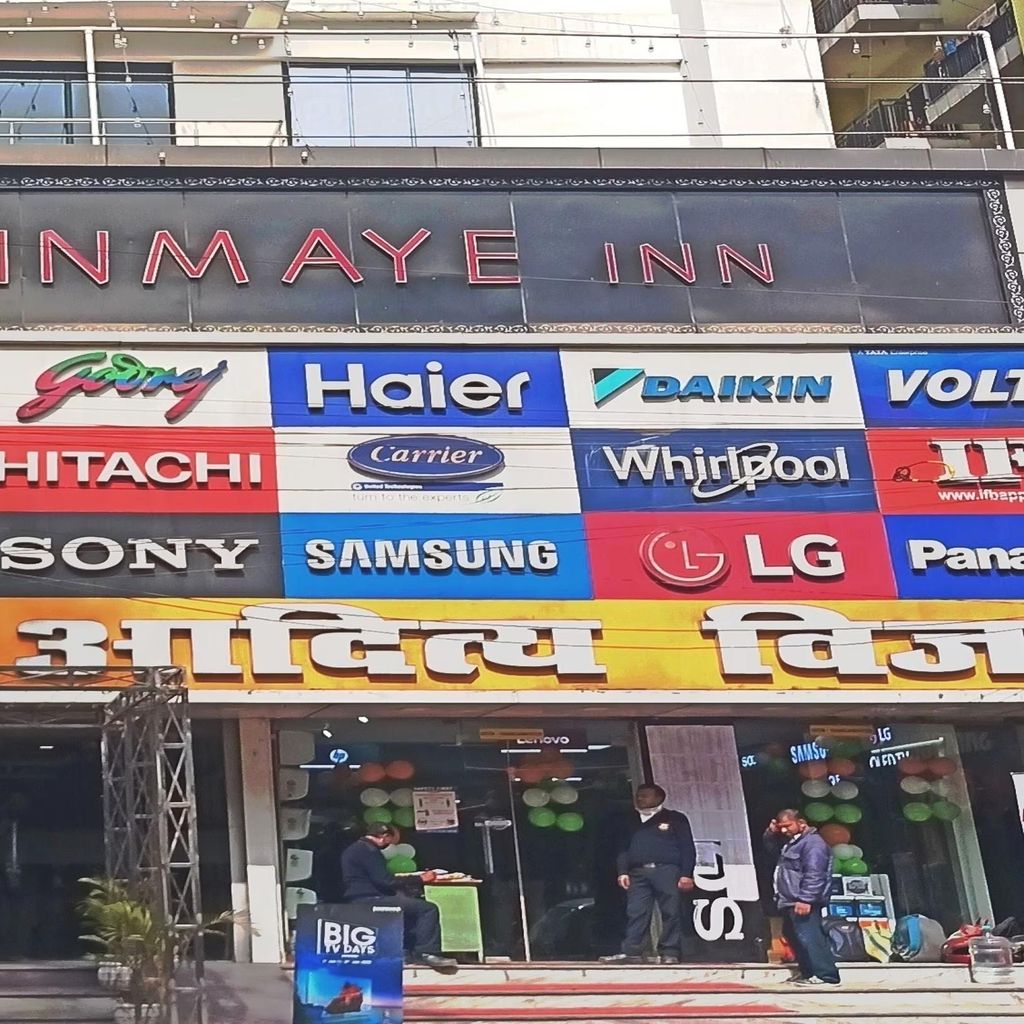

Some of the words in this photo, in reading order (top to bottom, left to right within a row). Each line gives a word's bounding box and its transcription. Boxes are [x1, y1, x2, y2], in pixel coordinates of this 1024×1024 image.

[603, 242, 775, 285] INN
[16, 351, 228, 423] Godrej
[304, 361, 530, 409] Haier
[642, 375, 833, 403] DAIKIN
[370, 446, 483, 464] Carrier
[603, 442, 850, 498] Whirlpool
[352, 493, 376, 501] turn
[382, 493, 394, 501] to
[398, 493, 417, 501] the
[422, 493, 470, 503] experts
[0, 535, 259, 571] SONY
[304, 538, 558, 570] SAMSUNG
[744, 533, 846, 577] LG
[16, 603, 607, 679] आदित्य
[878, 727, 891, 741] LG
[323, 921, 376, 946] BIG
[325, 944, 341, 954] TV
[343, 944, 376, 954] DAYS
